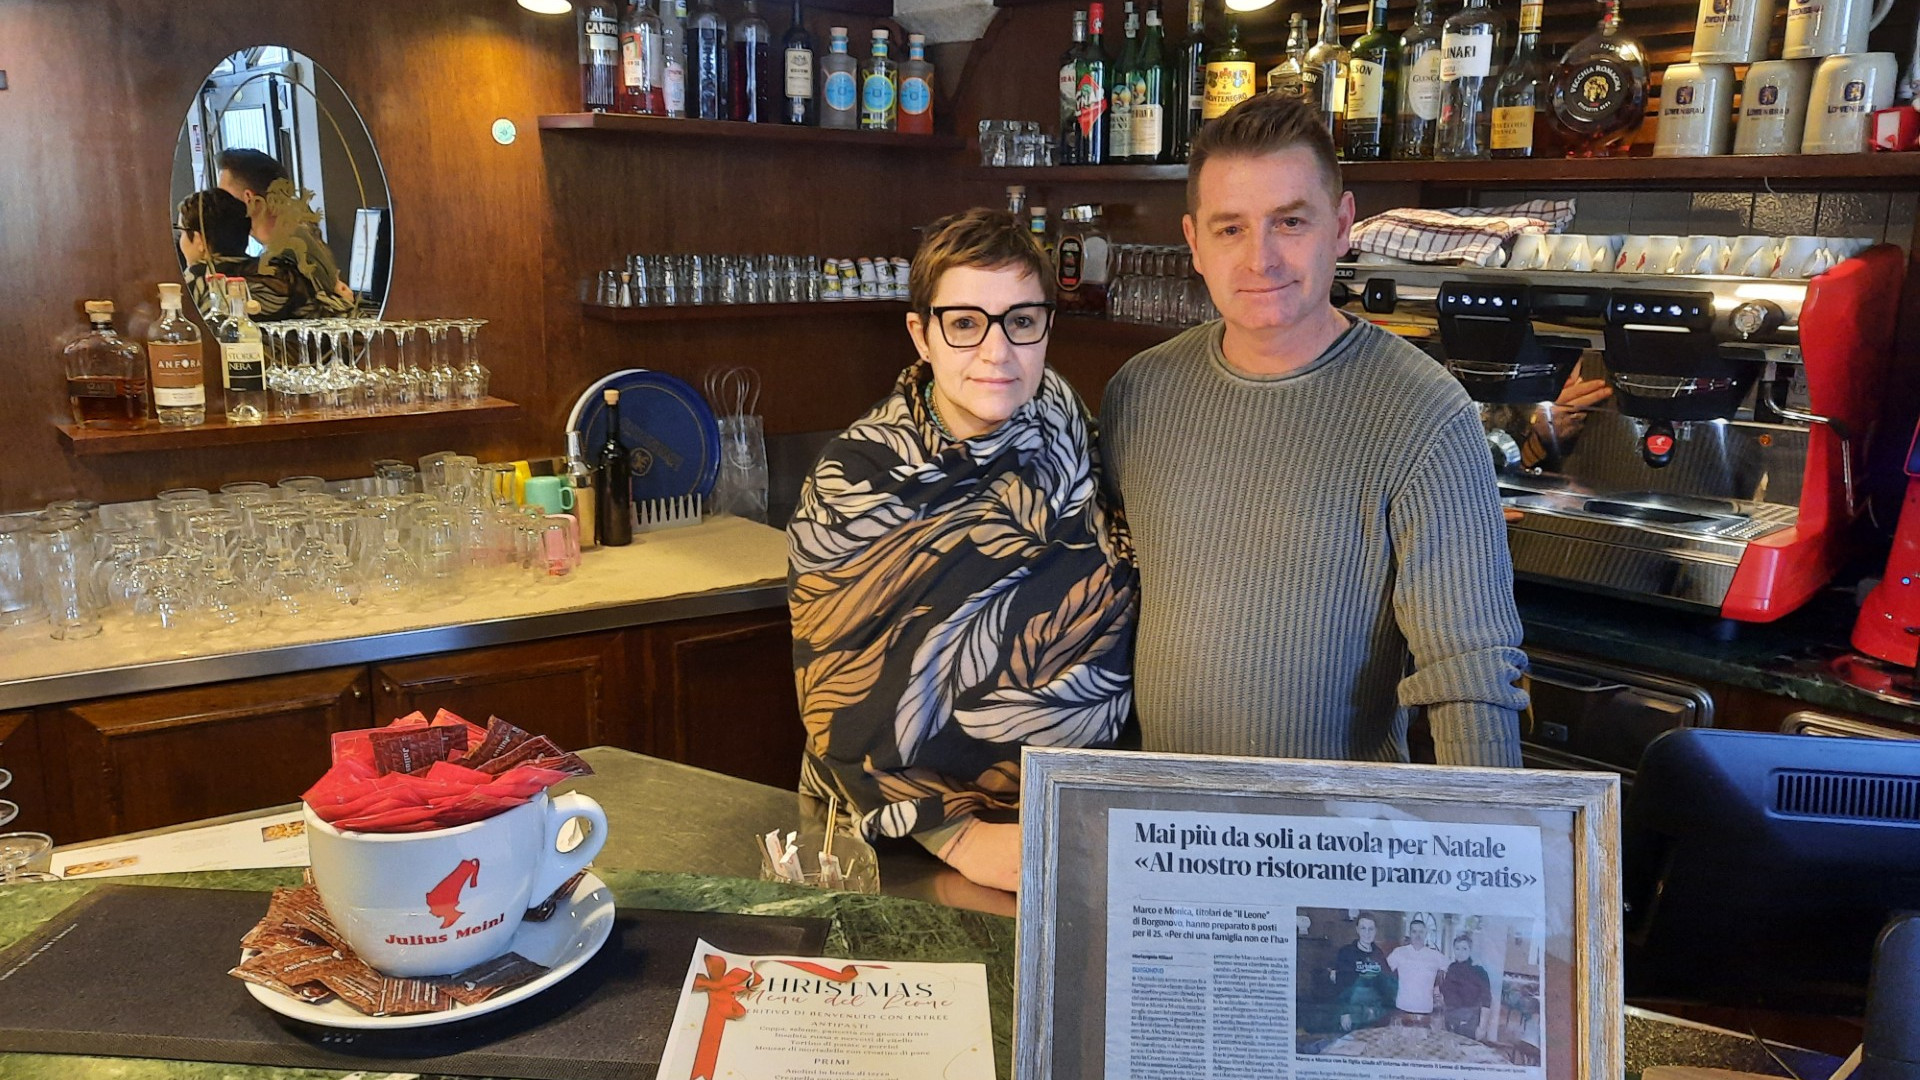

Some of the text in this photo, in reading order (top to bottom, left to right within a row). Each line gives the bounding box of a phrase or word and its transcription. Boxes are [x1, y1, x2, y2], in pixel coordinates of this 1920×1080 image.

[1302, 71, 1318, 84] BON
[1569, 64, 1621, 93] VECCHIA ROMAGNA
[1204, 91, 1248, 103] MONTENEGRO
[227, 352, 261, 361] STORICA
[157, 358, 201, 370] ANFORA
[228, 362, 253, 371] NERA
[402, 747, 412, 772] Julius
[1135, 822, 1506, 859] Mai più da soli a tavola per Natale
[1134, 851, 1537, 892] «Al nostro ristorante pranzo gratis»
[1133, 905, 1157, 914] Marco
[1164, 906, 1194, 917] Monica,
[1195, 907, 1222, 917] titolari
[1222, 908, 1233, 917] de
[385, 912, 505, 946] Julius Meinl
[1141, 917, 1184, 928] Borgonovo,
[1185, 919, 1210, 929] hanno
[1211, 921, 1250, 932] preparato
[1251, 923, 1256, 931] 8
[1257, 924, 1277, 933] posti
[1132, 930, 1145, 939] per
[1146, 929, 1151, 937] il
[1183, 931, 1194, 940] chi
[1195, 932, 1211, 941] una
[1211, 932, 1242, 943] famiglia
[1244, 935, 1259, 943] non
[824, 994, 865, 1007] del
[882, 993, 953, 1010] Leone
[810, 1011, 876, 1020] BENVENUTO
[811, 1021, 868, 1029] ANTIPASTI
